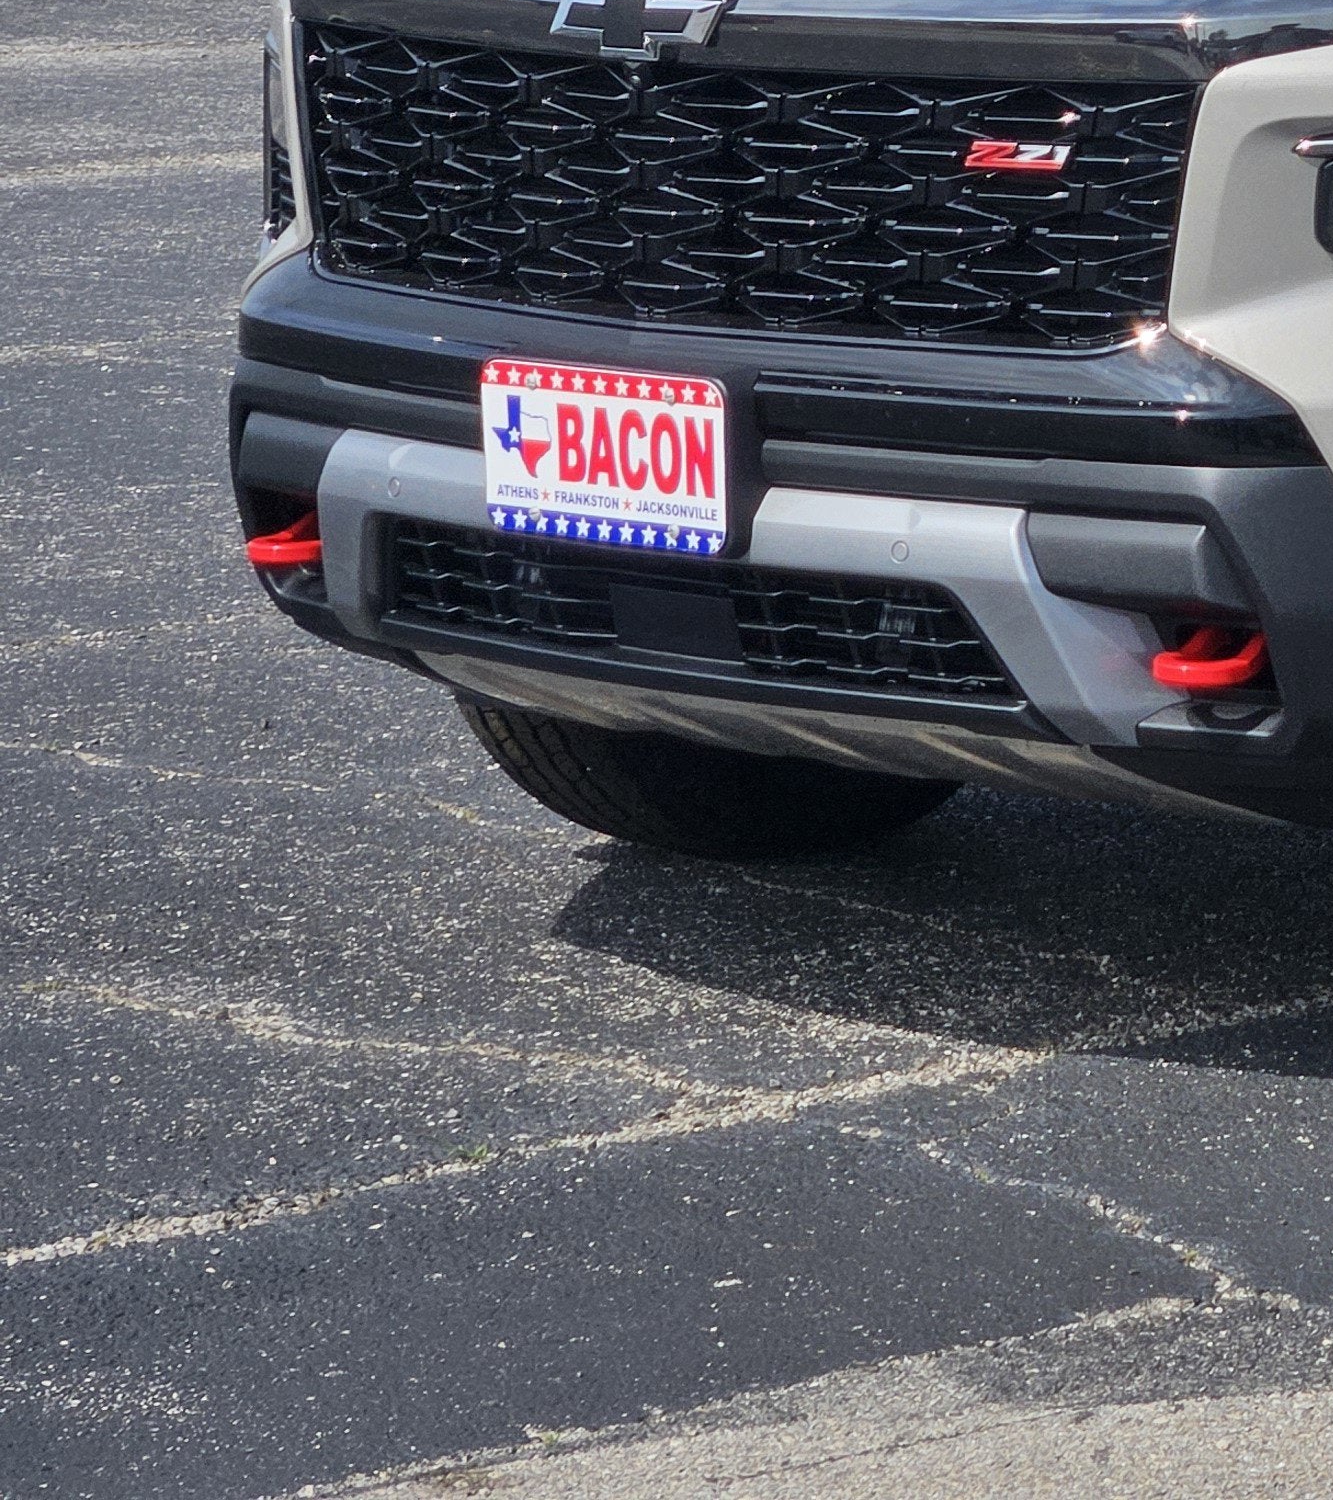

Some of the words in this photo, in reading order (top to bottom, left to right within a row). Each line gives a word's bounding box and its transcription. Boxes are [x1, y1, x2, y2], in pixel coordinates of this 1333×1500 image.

[964, 140, 1072, 171] Z71
[556, 402, 716, 499] BACON
[497, 484, 539, 501] ATHENS
[554, 490, 620, 510] FRANKSTON
[635, 500, 718, 521] JACKSONVILLE
